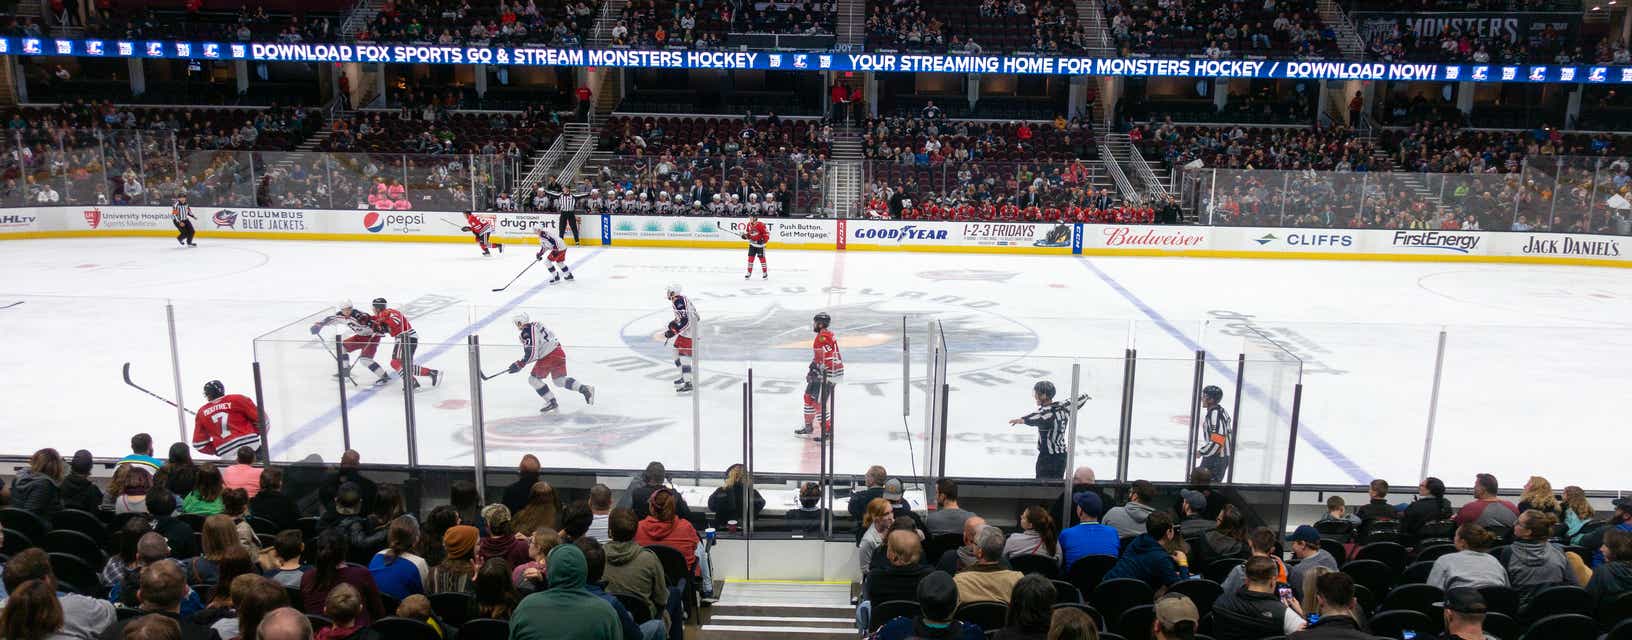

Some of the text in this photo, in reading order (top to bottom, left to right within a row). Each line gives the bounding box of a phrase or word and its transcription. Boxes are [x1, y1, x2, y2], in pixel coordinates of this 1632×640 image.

[1405, 17, 1519, 44] MONSTERS
[252, 44, 352, 61] DOWNLOAD
[357, 46, 391, 62] FOX
[395, 46, 463, 63] SPORTS
[467, 47, 492, 64] GO
[496, 48, 510, 64] &
[514, 48, 584, 66] STREAM
[588, 49, 683, 67] MONSTERS
[688, 52, 757, 68] HOCKEY
[849, 54, 896, 71] YOUR
[901, 55, 999, 73] STREAMING
[1003, 57, 1053, 74] HOME
[1058, 57, 1092, 75] FOR
[1096, 58, 1190, 76] MONSTERS
[1194, 60, 1264, 77] HOCKEY
[1286, 62, 1385, 79] DOWNLOAD
[1388, 64, 1438, 80] NOW!
[102, 213, 139, 221] University
[241, 210, 304, 219] COLUMBUS
[386, 213, 424, 227] pepsi
[242, 219, 305, 231] BLUE JACKETS
[500, 217, 526, 231] drug
[963, 223, 1036, 238] 1-2-3 FRIDAYS
[1103, 227, 1204, 247] Budweiser
[1286, 233, 1353, 247] CLIFFS
[1392, 231, 1480, 250] FirstEnergy
[1522, 236, 1558, 254] JACK
[211, 411, 232, 439] 7
